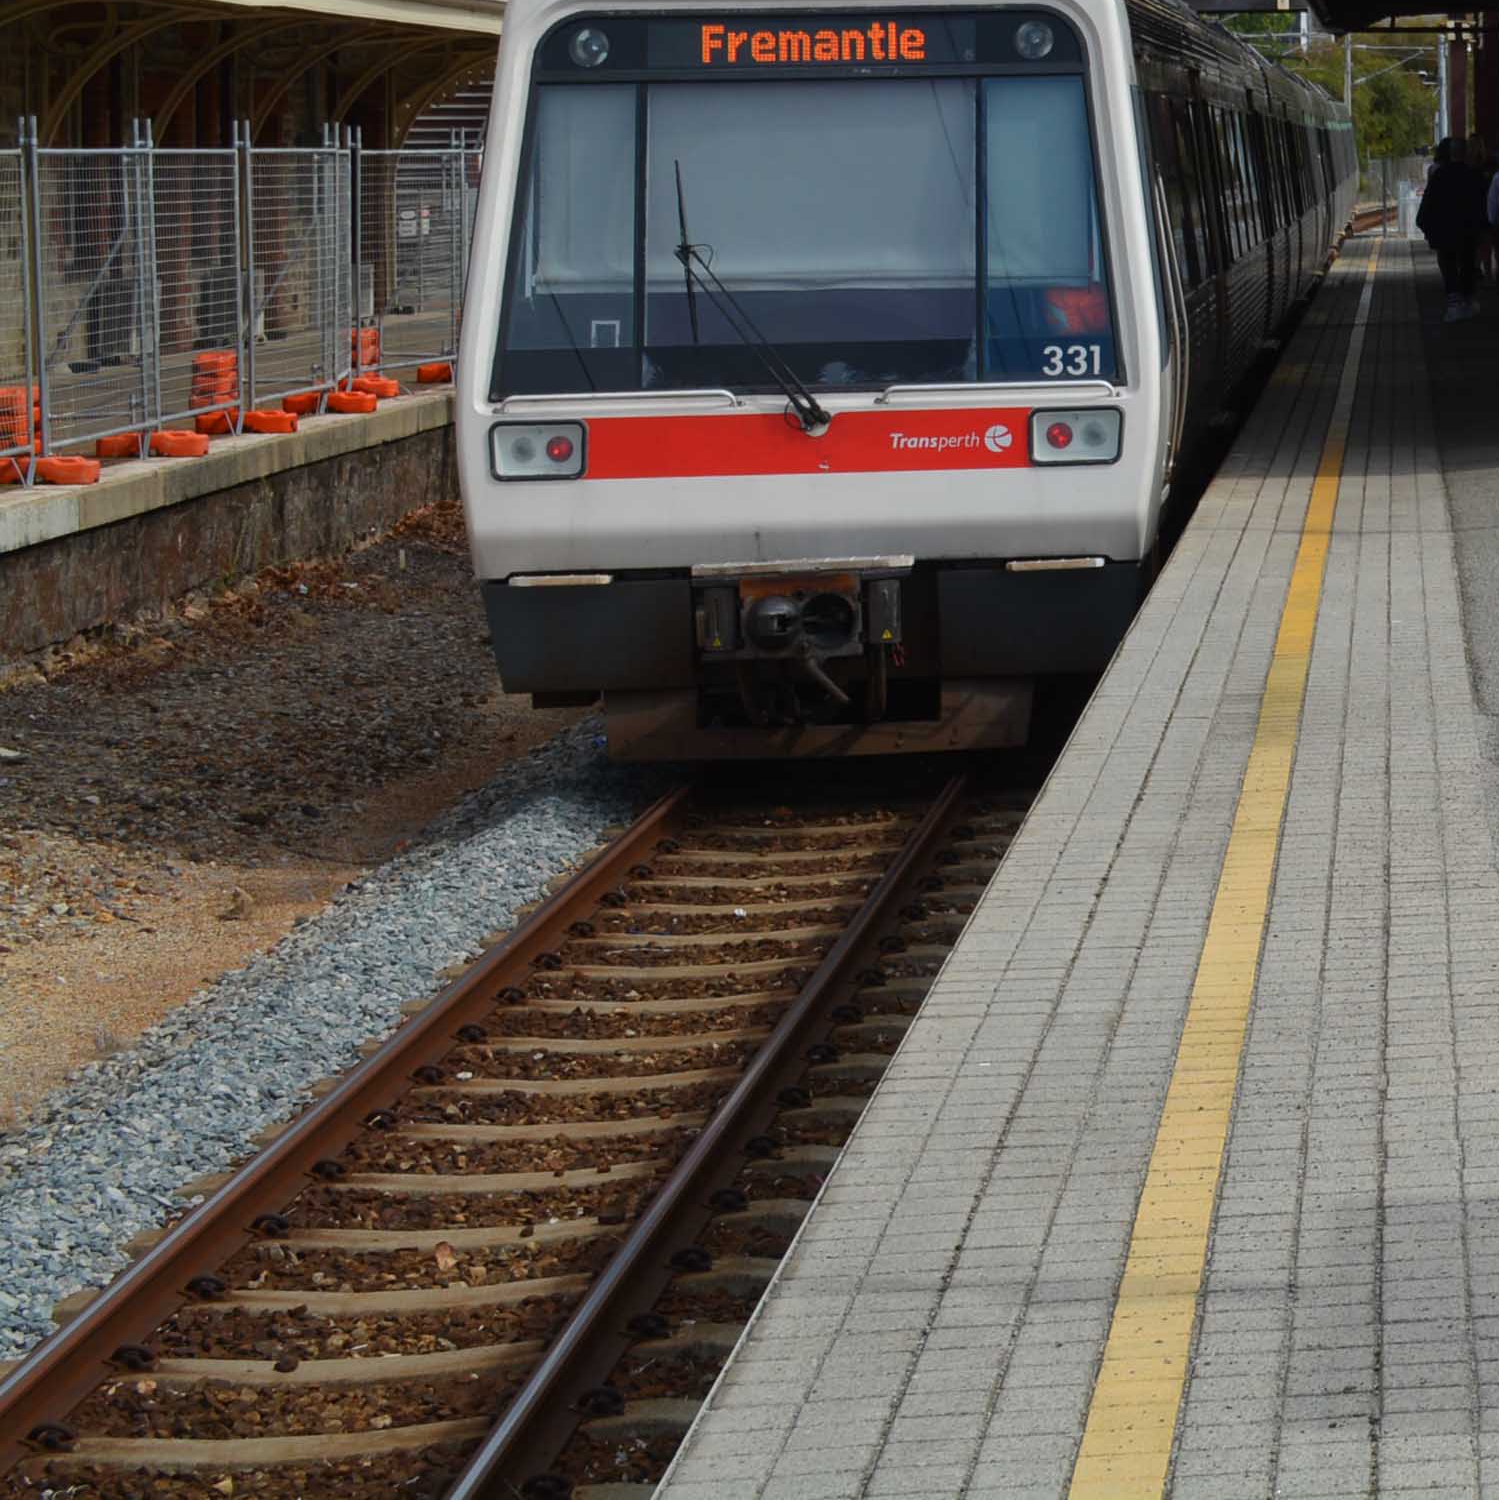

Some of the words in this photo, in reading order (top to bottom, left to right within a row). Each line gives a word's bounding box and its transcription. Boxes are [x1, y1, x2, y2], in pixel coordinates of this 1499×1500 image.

[701, 21, 926, 64] Fremantle
[1041, 345, 1103, 377] 331
[889, 432, 981, 453] Transperth
